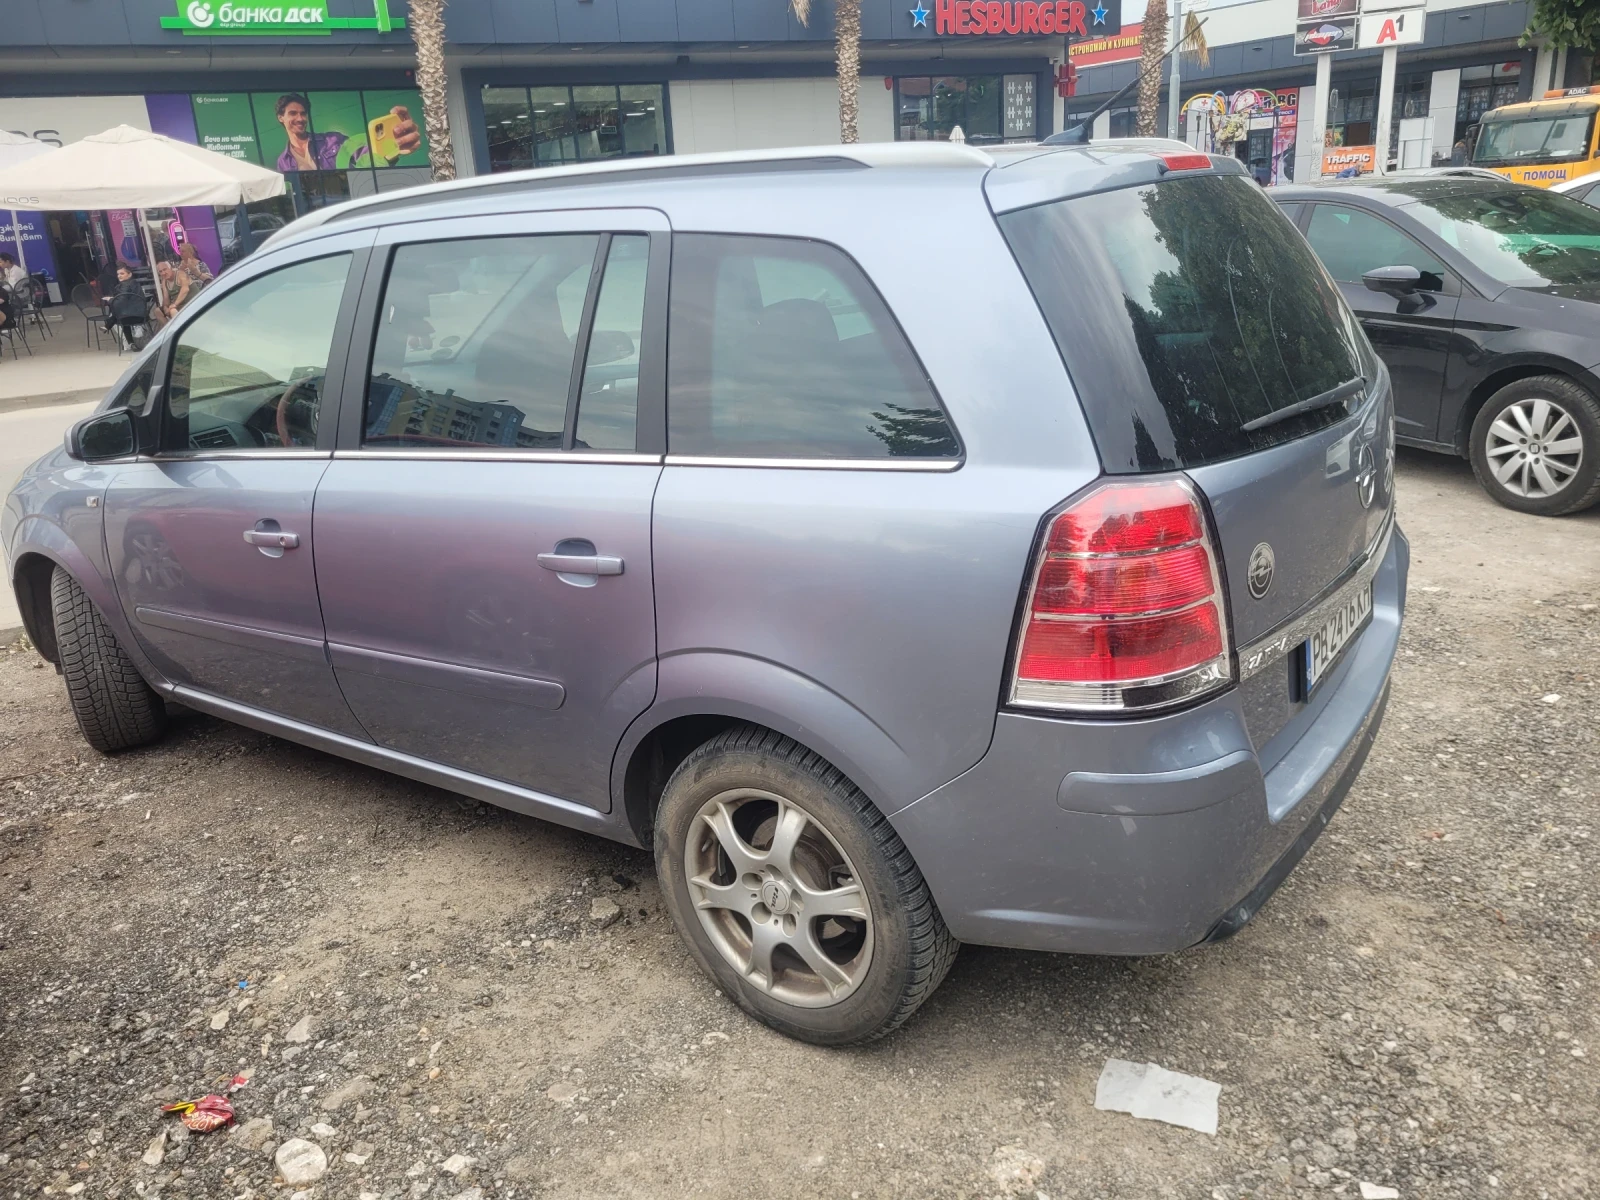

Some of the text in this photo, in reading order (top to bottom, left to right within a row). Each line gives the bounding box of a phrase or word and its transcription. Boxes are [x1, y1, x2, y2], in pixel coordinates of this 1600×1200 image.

[219, 3, 282, 23] банка
[936, 0, 1087, 36] HESBURGER
[1376, 14, 1405, 44] A1
[1567, 87, 1587, 96] ADAC
[1325, 152, 1371, 165] TRAFFIC
[1523, 169, 1567, 181] ПОМОЩ
[3, 196, 40, 205] IQOS
